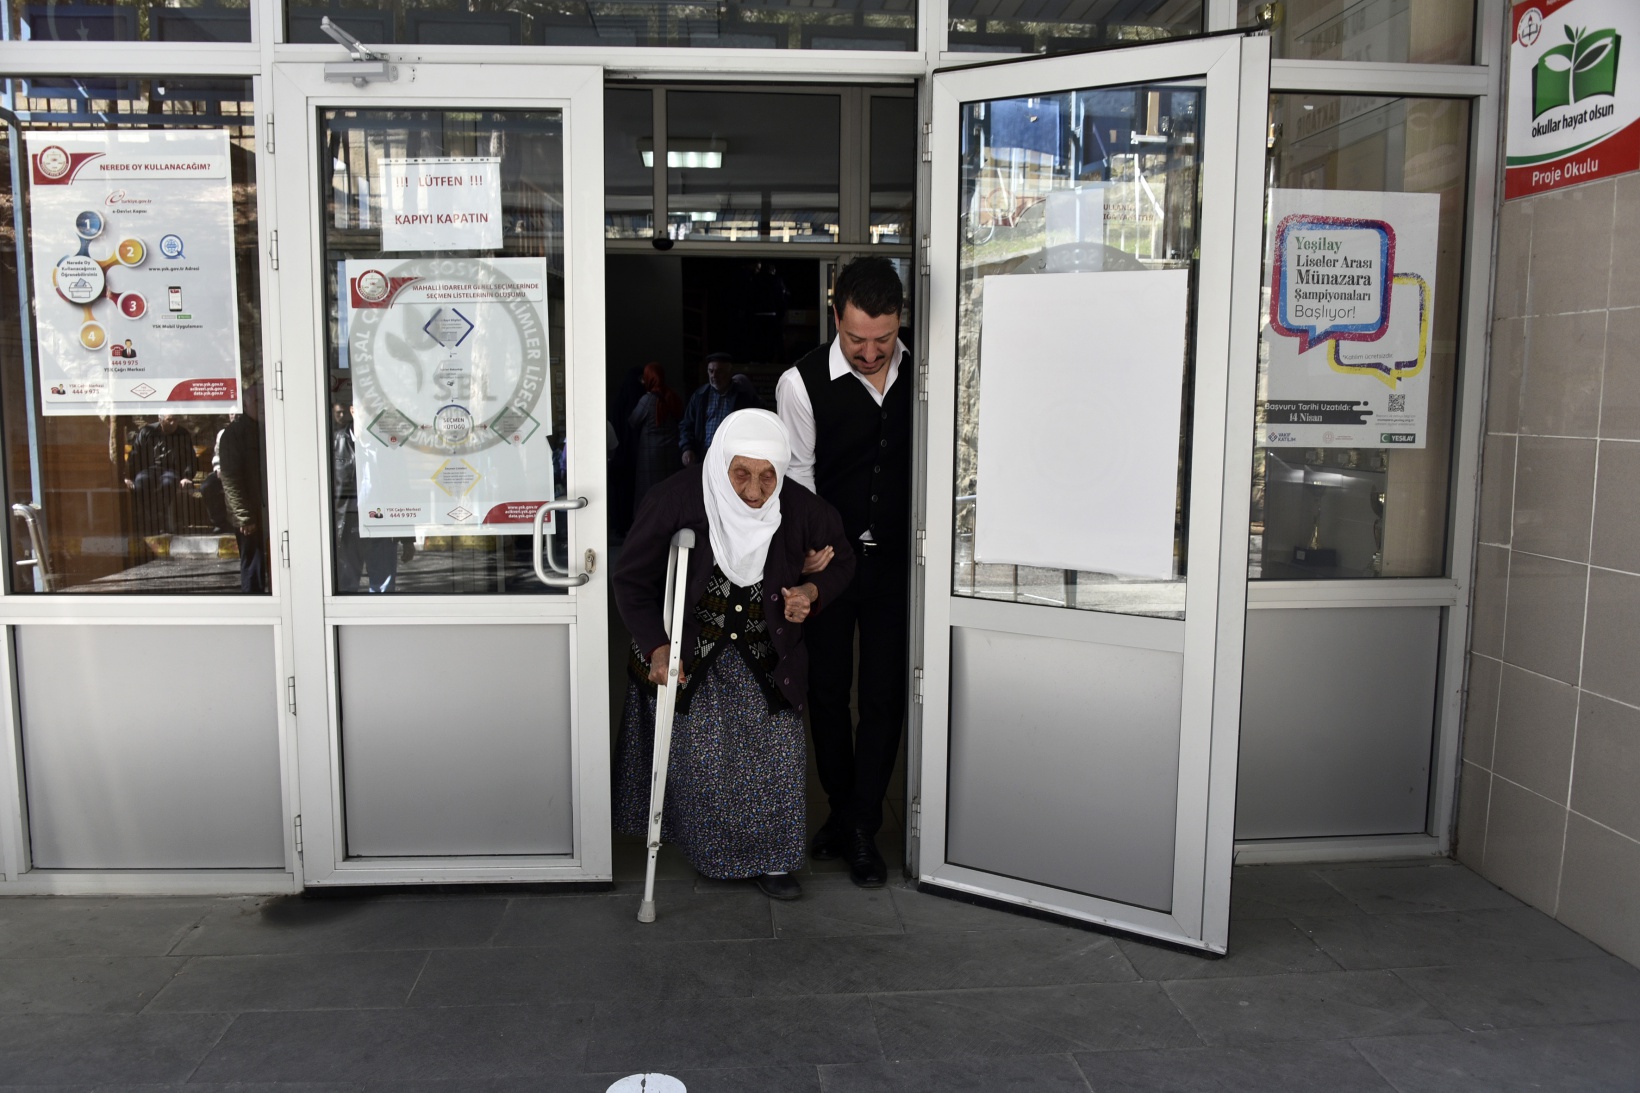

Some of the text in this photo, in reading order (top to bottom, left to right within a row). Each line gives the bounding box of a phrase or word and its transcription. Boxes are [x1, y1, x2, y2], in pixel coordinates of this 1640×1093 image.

[1532, 103, 1614, 138] okullar hayat olsun
[132, 163, 142, 171] OY
[144, 162, 211, 171] KULLANACAĞIM?
[1532, 158, 1599, 187] Proje Okulu
[419, 174, 463, 187] LÜTFEN
[470, 175, 483, 186] !!!
[85, 219, 90, 231] 1
[395, 213, 488, 225] KAPIYI KAPATIN
[1295, 236, 1342, 254] Yeşilay
[126, 247, 134, 257] 2
[1296, 255, 1373, 269] Liseler Arası
[1296, 269, 1372, 286] Münazara
[494, 283, 539, 291] SEÇİMLERİNDE
[426, 291, 526, 300] SEÇMEN LİSTELERİNİN OLUŞUMU
[1294, 288, 1371, 303] Şampiyonaları
[129, 301, 137, 312] 3
[1294, 304, 1356, 322] Başlıyor!
[87, 331, 96, 342] 4
[1264, 403, 1296, 411] Başvuru
[1320, 403, 1352, 411] Uzatıldı:
[1289, 413, 1323, 422] 14 Nisan
